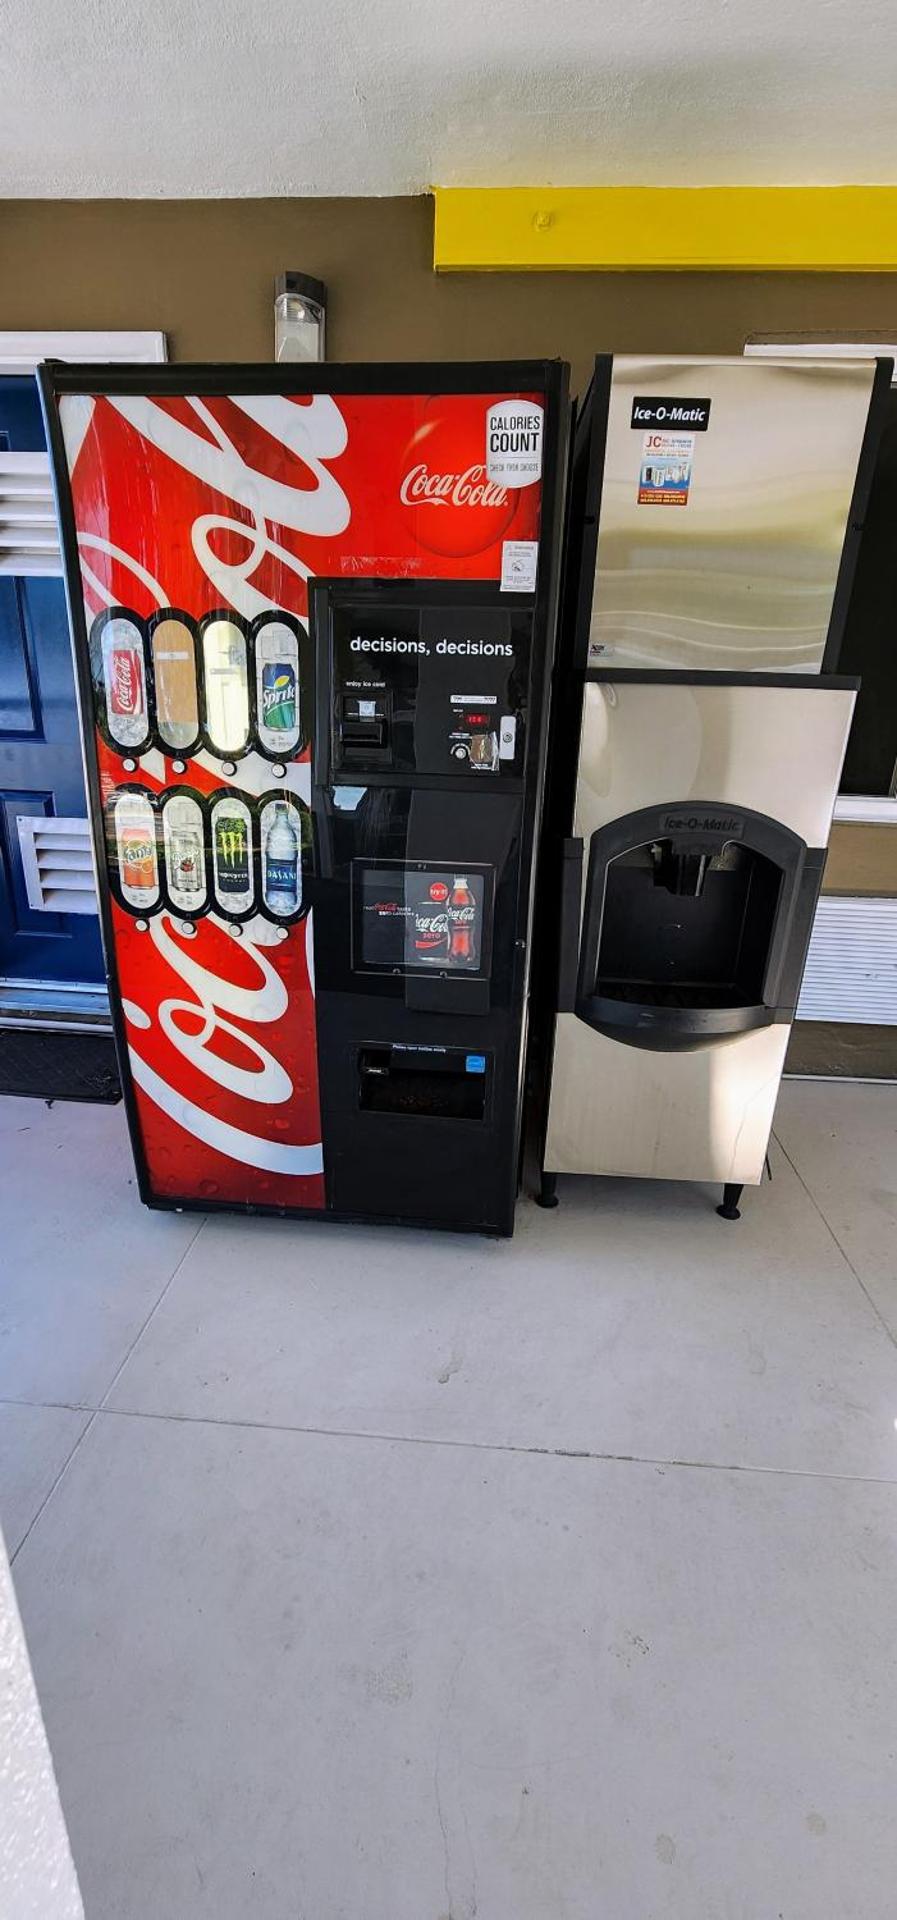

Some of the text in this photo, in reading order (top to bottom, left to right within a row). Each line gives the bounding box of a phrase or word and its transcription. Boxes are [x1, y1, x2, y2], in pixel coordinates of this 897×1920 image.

[634, 406, 705, 422] Ice-O-Matic
[490, 416, 540, 430] CALORIES
[490, 433, 539, 452] COUNT
[646, 436, 662, 448] JC
[400, 464, 508, 507] Coca-Cola
[350, 636, 513, 656] decisions, decisions
[264, 683, 295, 709] Sprite
[664, 816, 739, 831] Ice-O-Matic
[267, 870, 297, 880] DASANI
